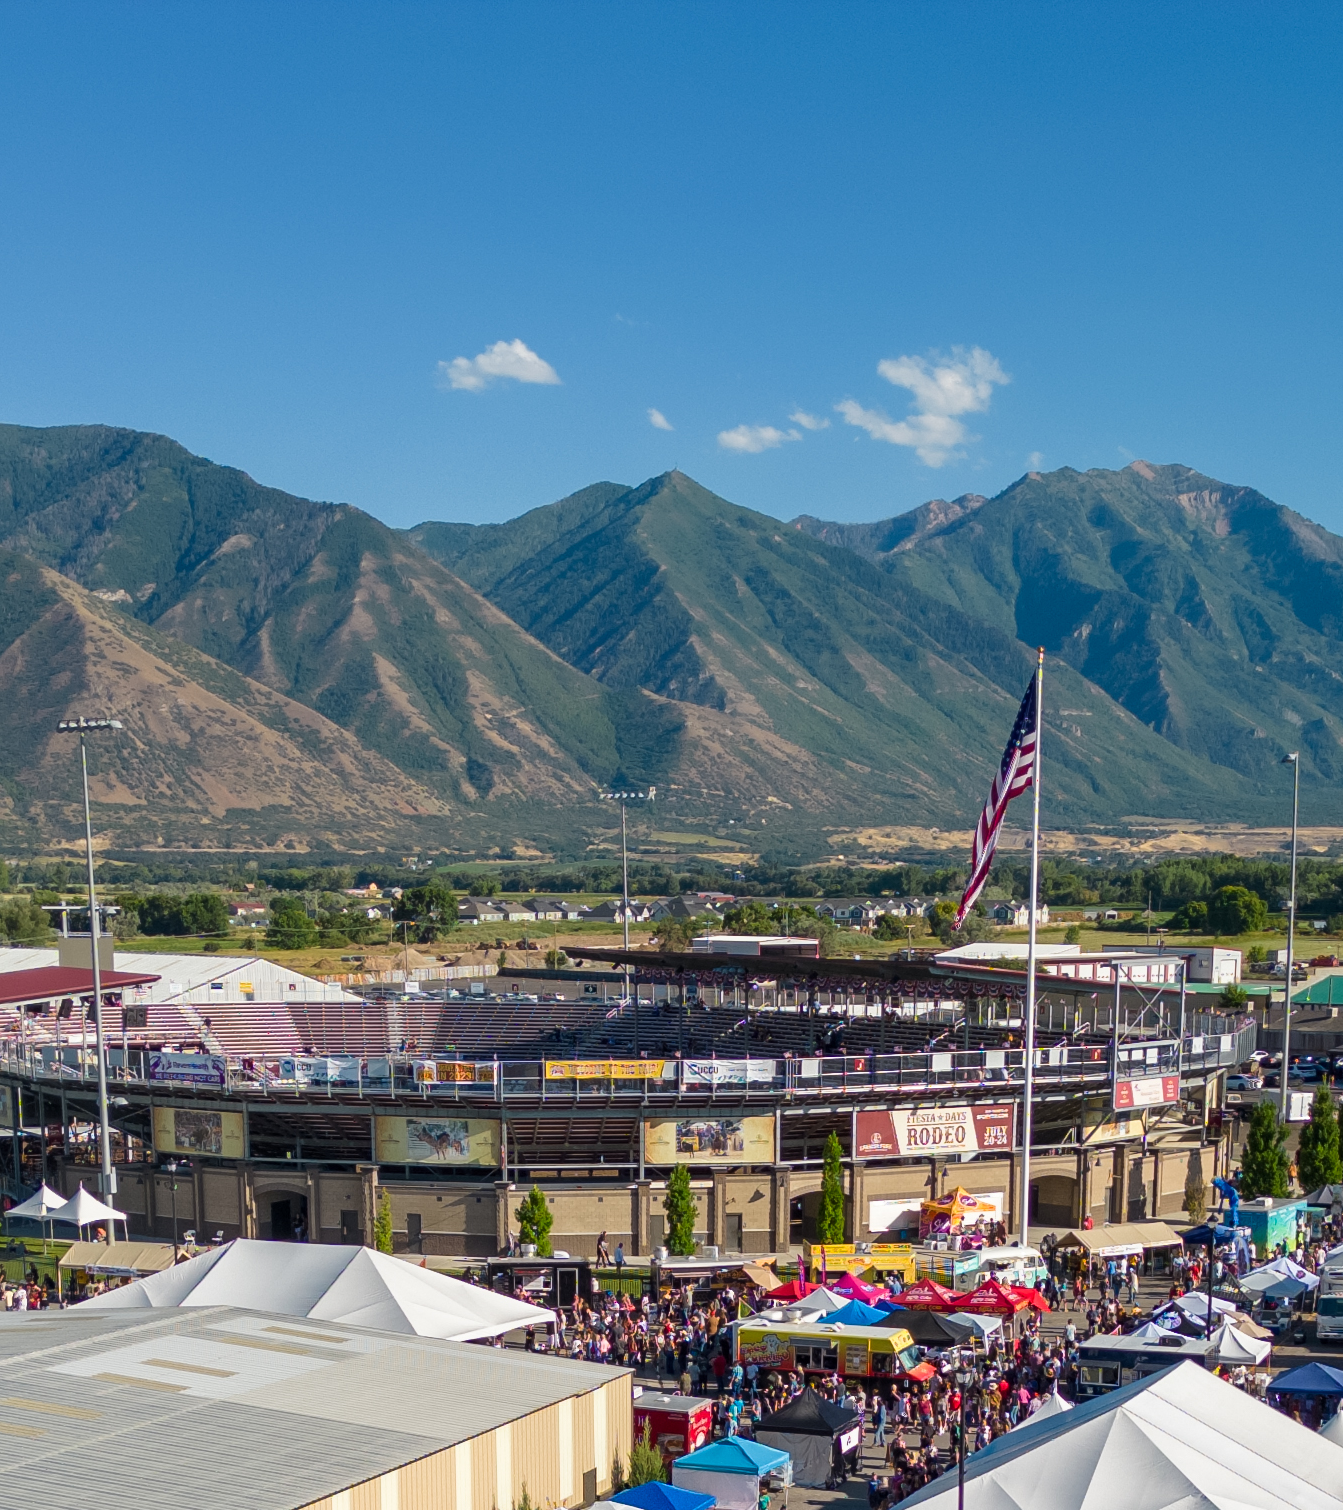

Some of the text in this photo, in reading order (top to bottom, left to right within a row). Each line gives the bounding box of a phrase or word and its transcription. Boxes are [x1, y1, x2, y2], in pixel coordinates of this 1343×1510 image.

[906, 1113, 936, 1124] FIESTA
[945, 1111, 967, 1122] DAYS
[906, 1125, 966, 1147] RODEO
[984, 1126, 1008, 1136] JULY
[984, 1135, 1008, 1146] 20-24
